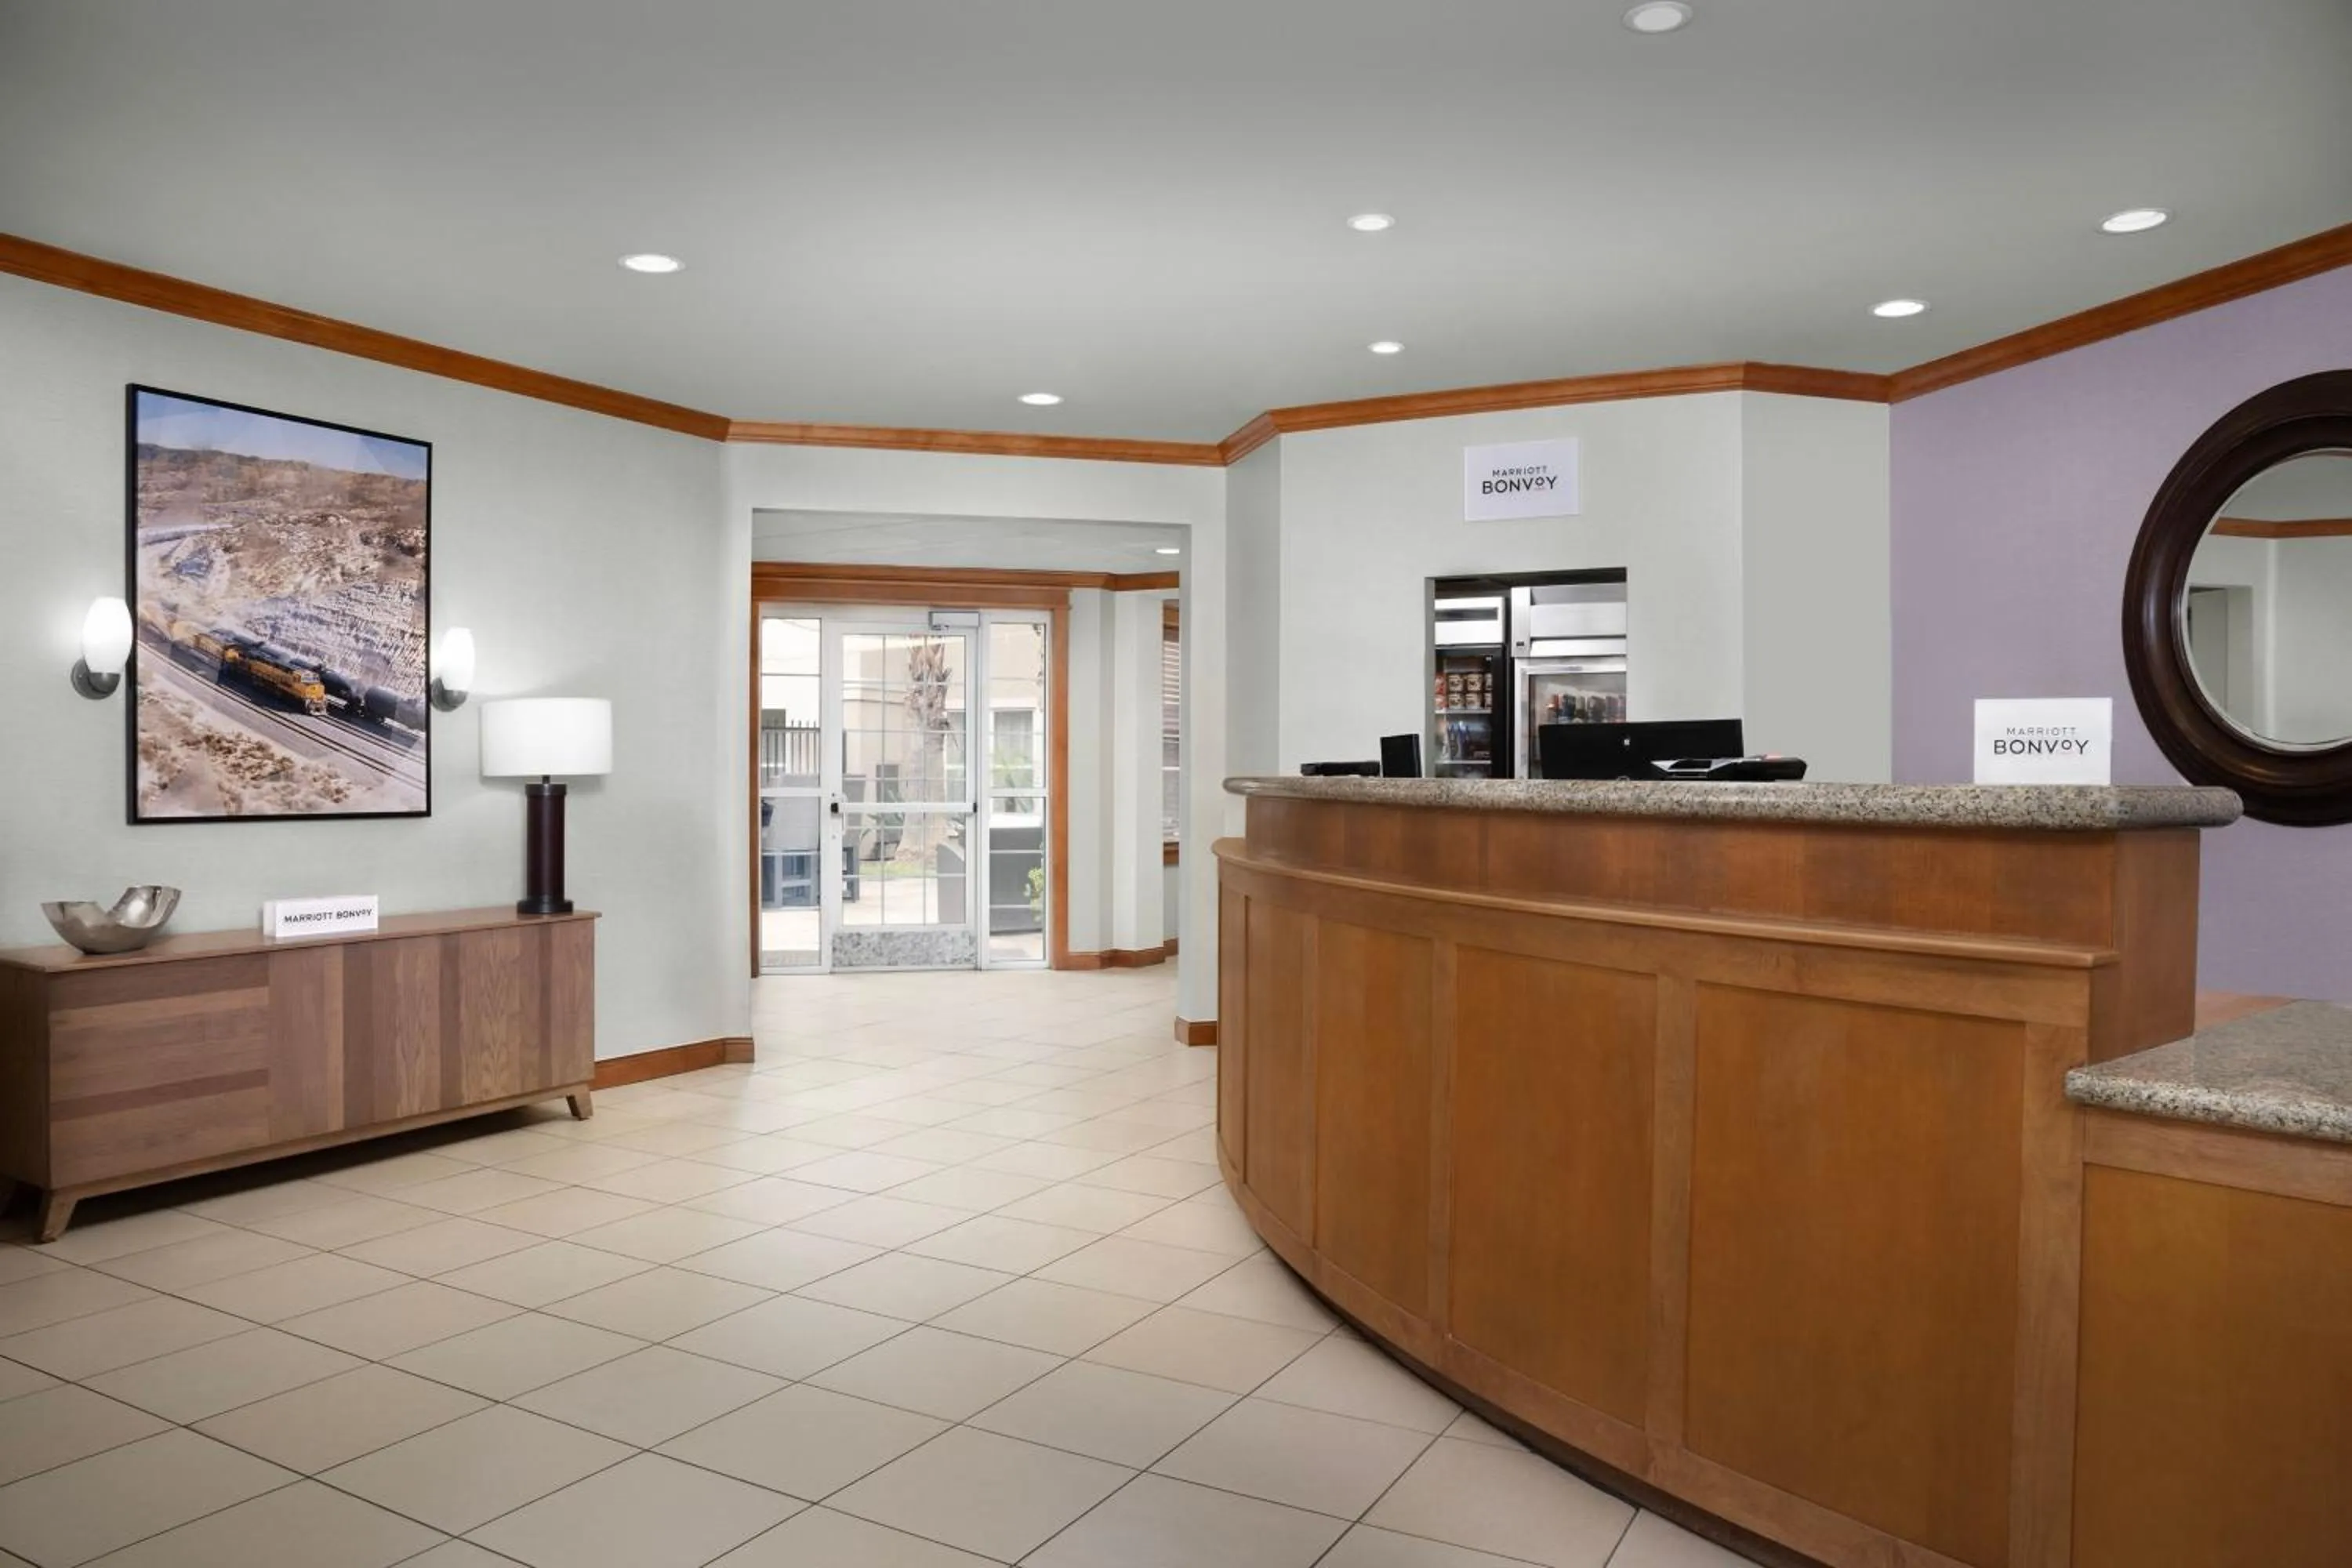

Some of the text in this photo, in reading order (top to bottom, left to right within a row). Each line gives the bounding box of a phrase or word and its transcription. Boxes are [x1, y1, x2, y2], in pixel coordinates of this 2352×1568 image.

[1492, 465, 1548, 477] MARRIOTT
[1482, 475, 1557, 495] BONVOY
[2006, 727, 2077, 736] MARRIOTT
[1994, 739, 2089, 754] BONVOY
[284, 912, 333, 923] MARRIOTT
